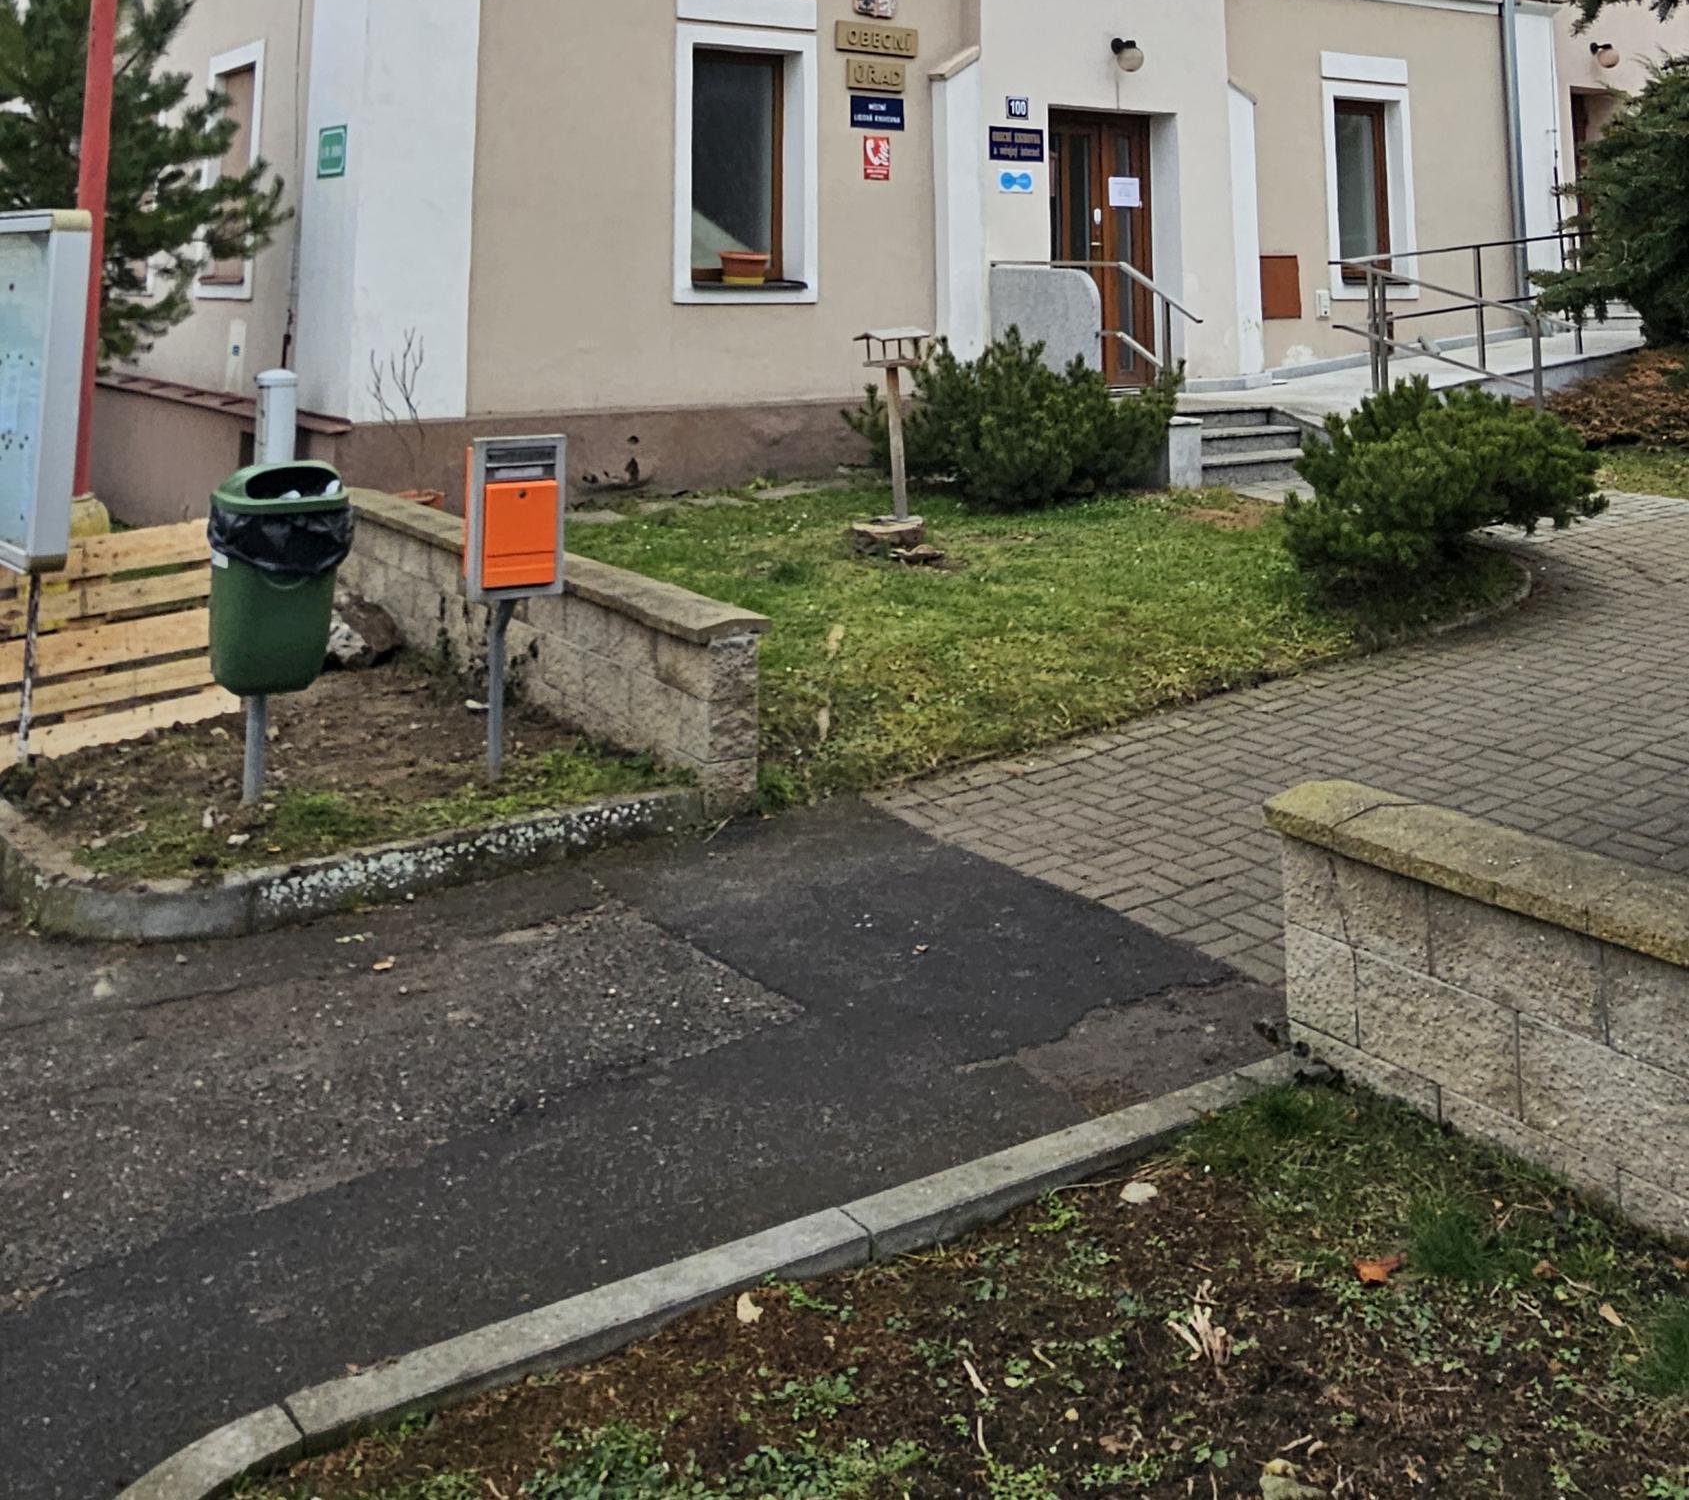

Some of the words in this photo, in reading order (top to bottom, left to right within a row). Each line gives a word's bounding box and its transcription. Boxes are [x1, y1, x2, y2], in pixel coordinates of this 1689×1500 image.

[847, 29, 912, 52] OBECNÍ
[853, 64, 902, 87] ÚŘAD
[1009, 100, 1027, 116] 100
